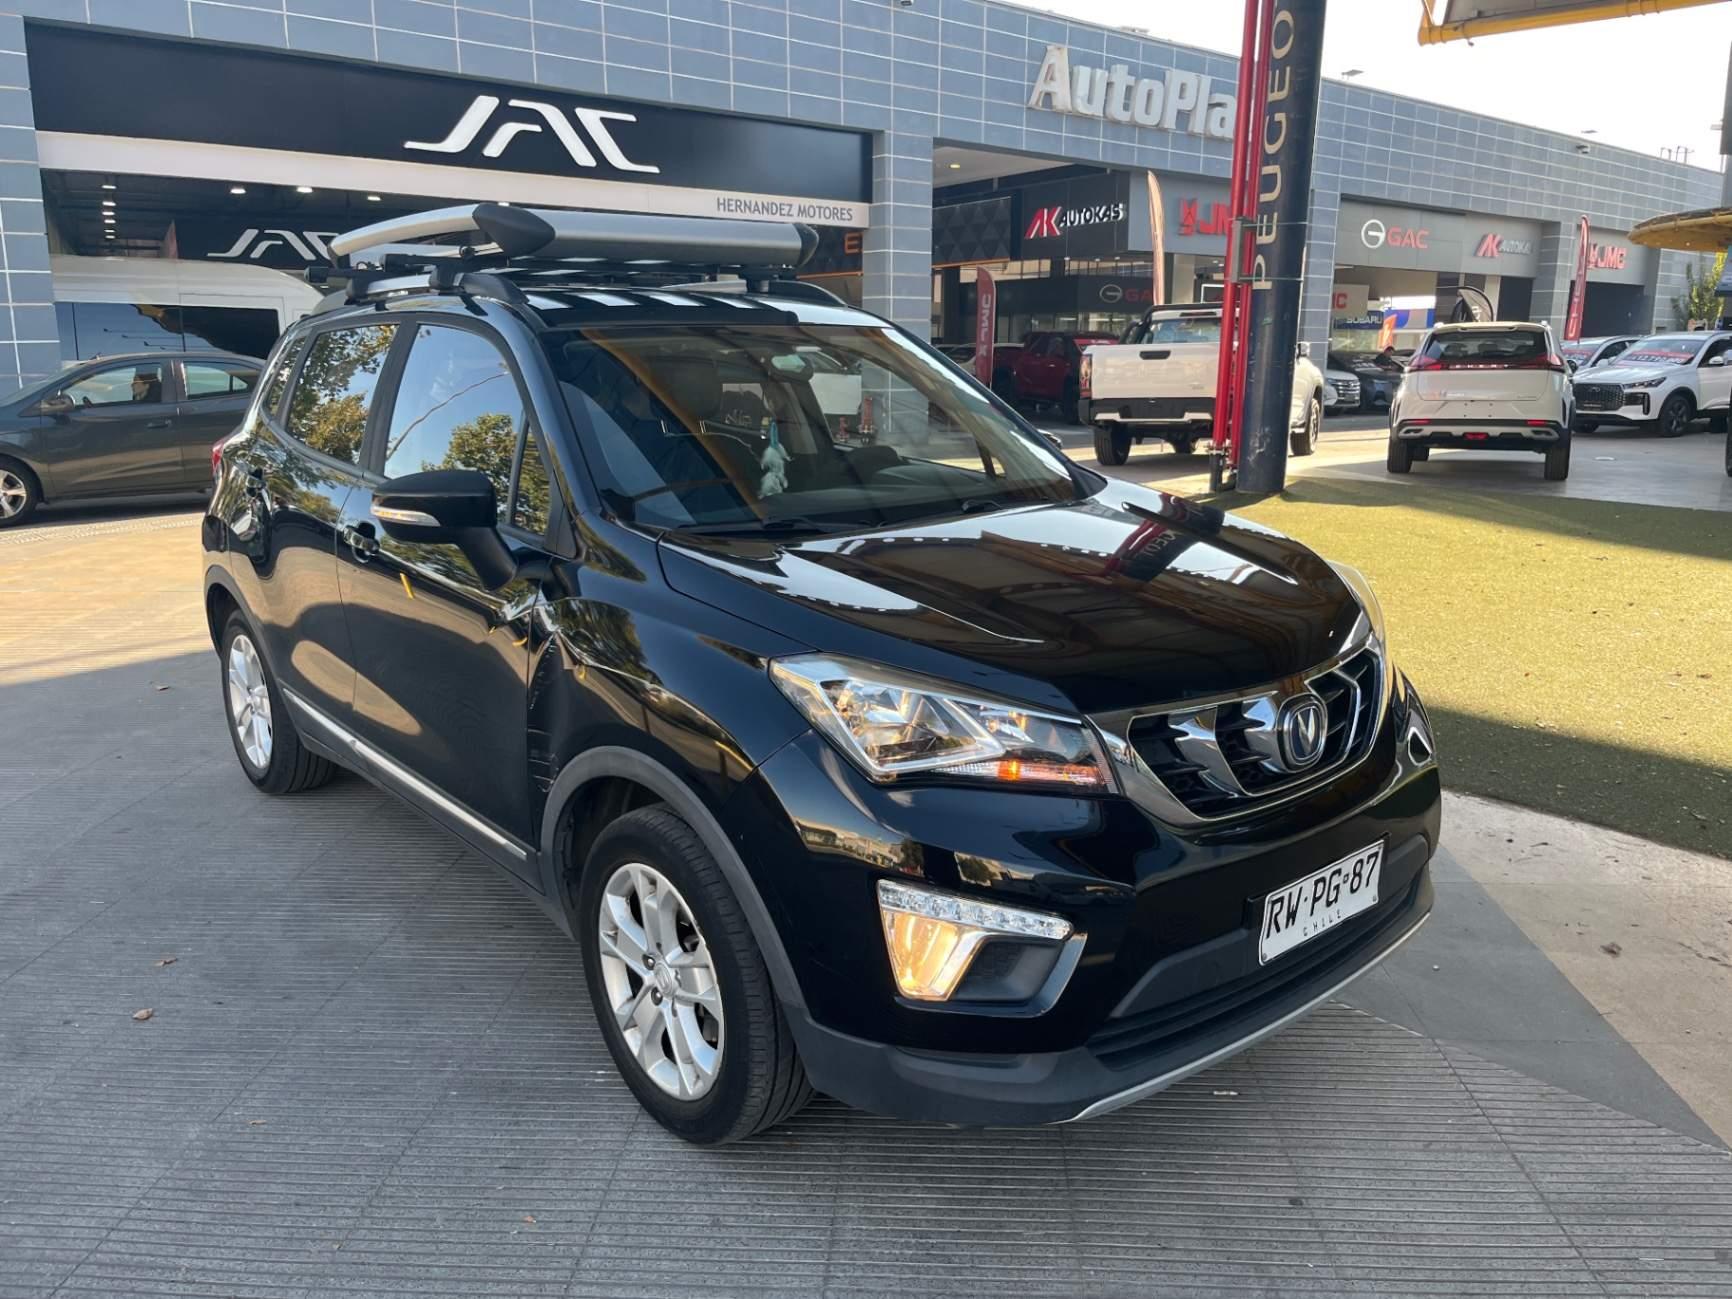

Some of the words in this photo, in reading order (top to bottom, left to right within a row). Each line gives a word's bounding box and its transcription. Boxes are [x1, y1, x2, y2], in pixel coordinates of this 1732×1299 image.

[404, 95, 660, 174] JAC
[1252, 0, 1296, 291] PEUGEO
[716, 197, 794, 217] HERNANDEZ
[797, 203, 853, 221] MOTORES
[207, 228, 341, 261] JAC
[1387, 227, 1430, 249] GAC
[1302, 908, 1342, 937] CHILE
